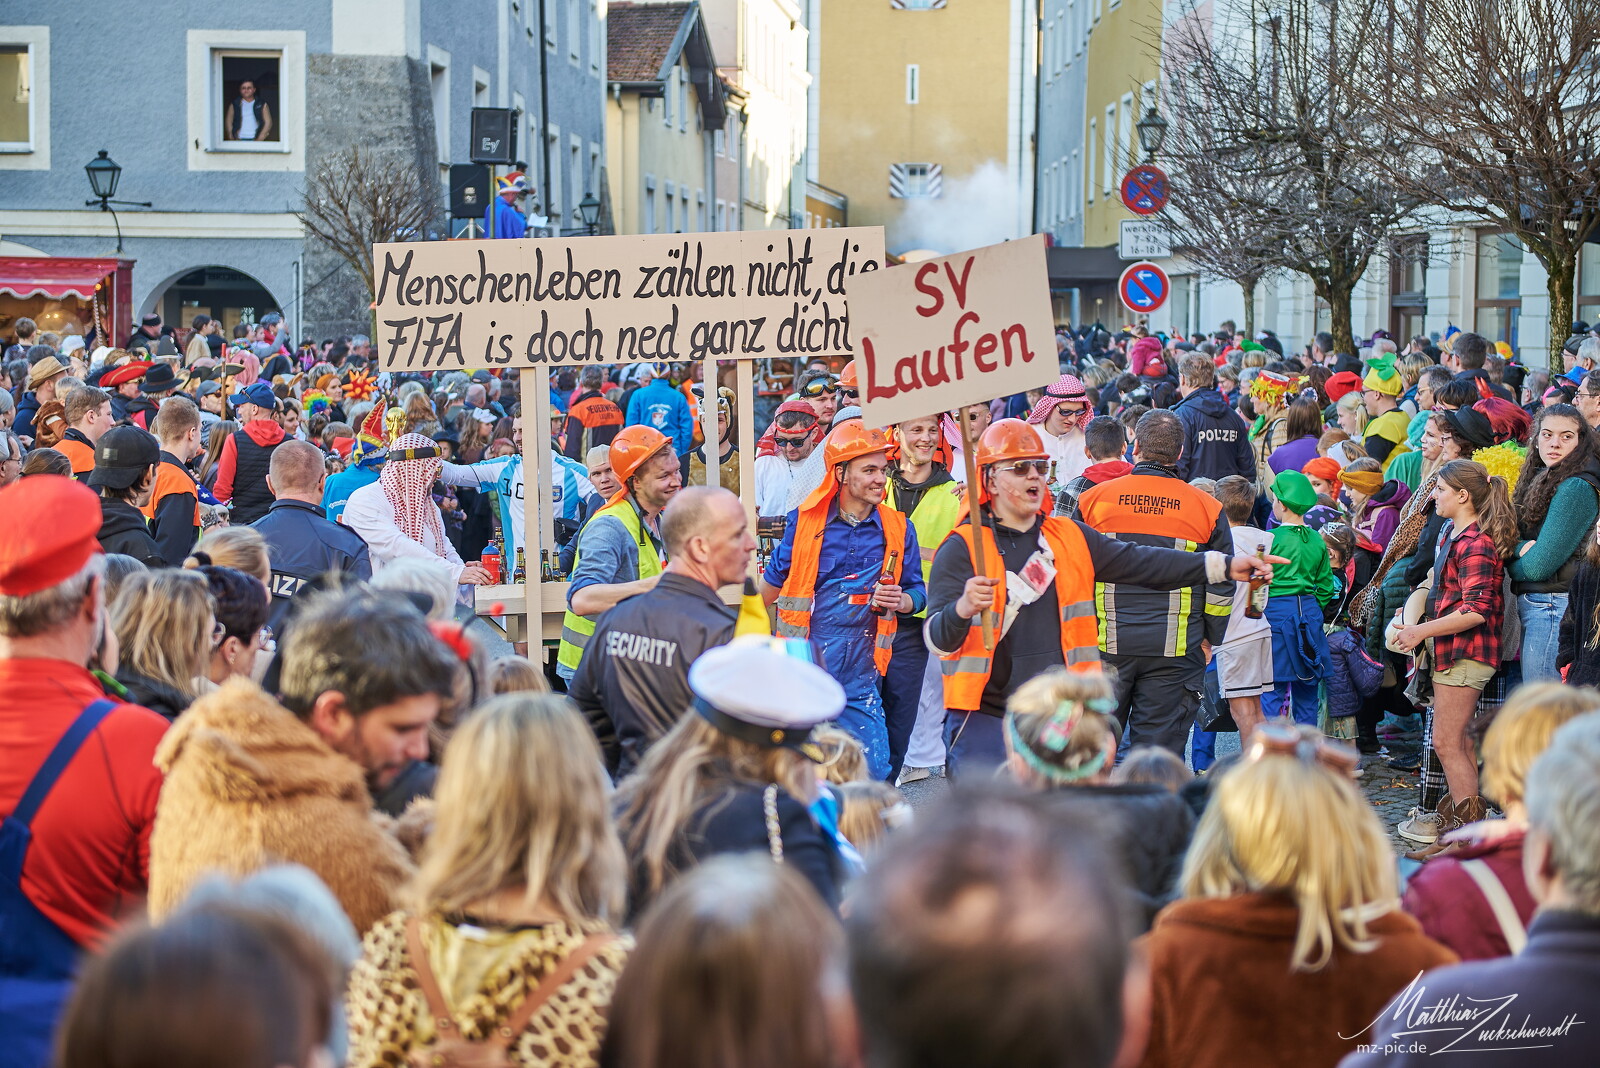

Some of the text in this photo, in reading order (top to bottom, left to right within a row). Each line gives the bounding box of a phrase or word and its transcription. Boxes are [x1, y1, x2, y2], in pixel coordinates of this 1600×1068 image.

[376, 247, 621, 306] Menschenleben
[633, 241, 737, 299] zählen
[747, 236, 822, 305] nicht,
[914, 256, 976, 318] SV
[383, 301, 854, 367] FIFA is doch ned ganz dicht
[861, 311, 1036, 404] Laufen
[1118, 494, 1181, 511] FEUERWEHR
[1133, 505, 1164, 516] LAUFEN
[606, 630, 677, 668] SECURITY
